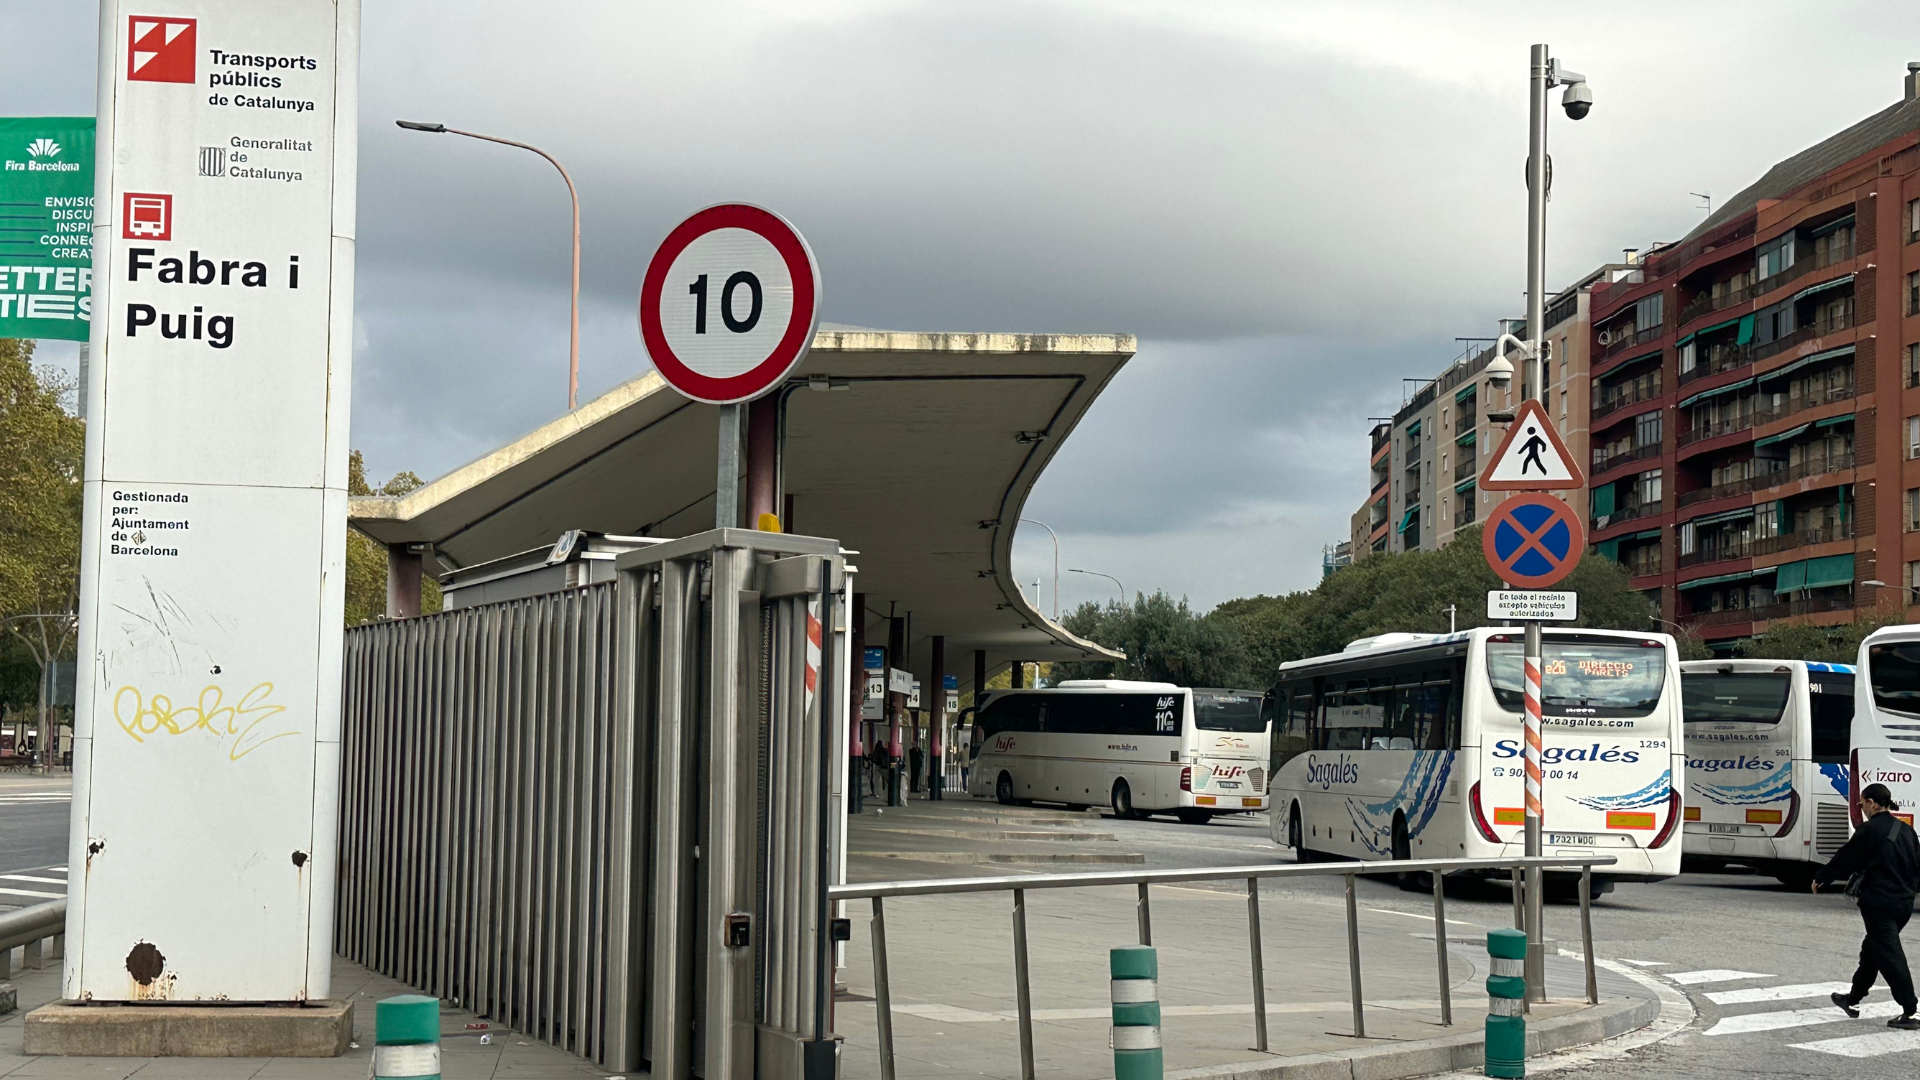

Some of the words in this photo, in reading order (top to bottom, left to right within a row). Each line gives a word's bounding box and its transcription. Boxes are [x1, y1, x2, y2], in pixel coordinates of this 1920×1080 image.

[209, 49, 317, 71] Transports
[209, 70, 282, 88] públics
[208, 93, 229, 106] de
[234, 94, 315, 113] Catalunya
[230, 136, 313, 152] Generalitat
[229, 151, 248, 163] de
[5, 160, 25, 171] Fira
[28, 160, 80, 172] Barcelona
[229, 166, 303, 183] Catalunya
[56, 222, 94, 233] INSPI
[128, 247, 267, 288] Fabra
[289, 255, 299, 289] i
[689, 270, 763, 334] 10
[126, 303, 234, 349] Puig
[112, 490, 189, 503] Gestionada
[112, 505, 139, 517] per:
[111, 517, 190, 530] Ajuntament
[111, 531, 128, 542] de
[110, 544, 178, 557] Barcelona
[870, 684, 882, 693] 13
[908, 694, 918, 703] 14
[1639, 740, 1666, 749] 1294
[1212, 764, 1246, 780] hife
[1307, 753, 1358, 790] Sagalés
[1509, 768, 1525, 778] 90
[1549, 769, 1563, 779] 00
[1566, 770, 1579, 780] 14
[1876, 767, 1912, 783] izaro
